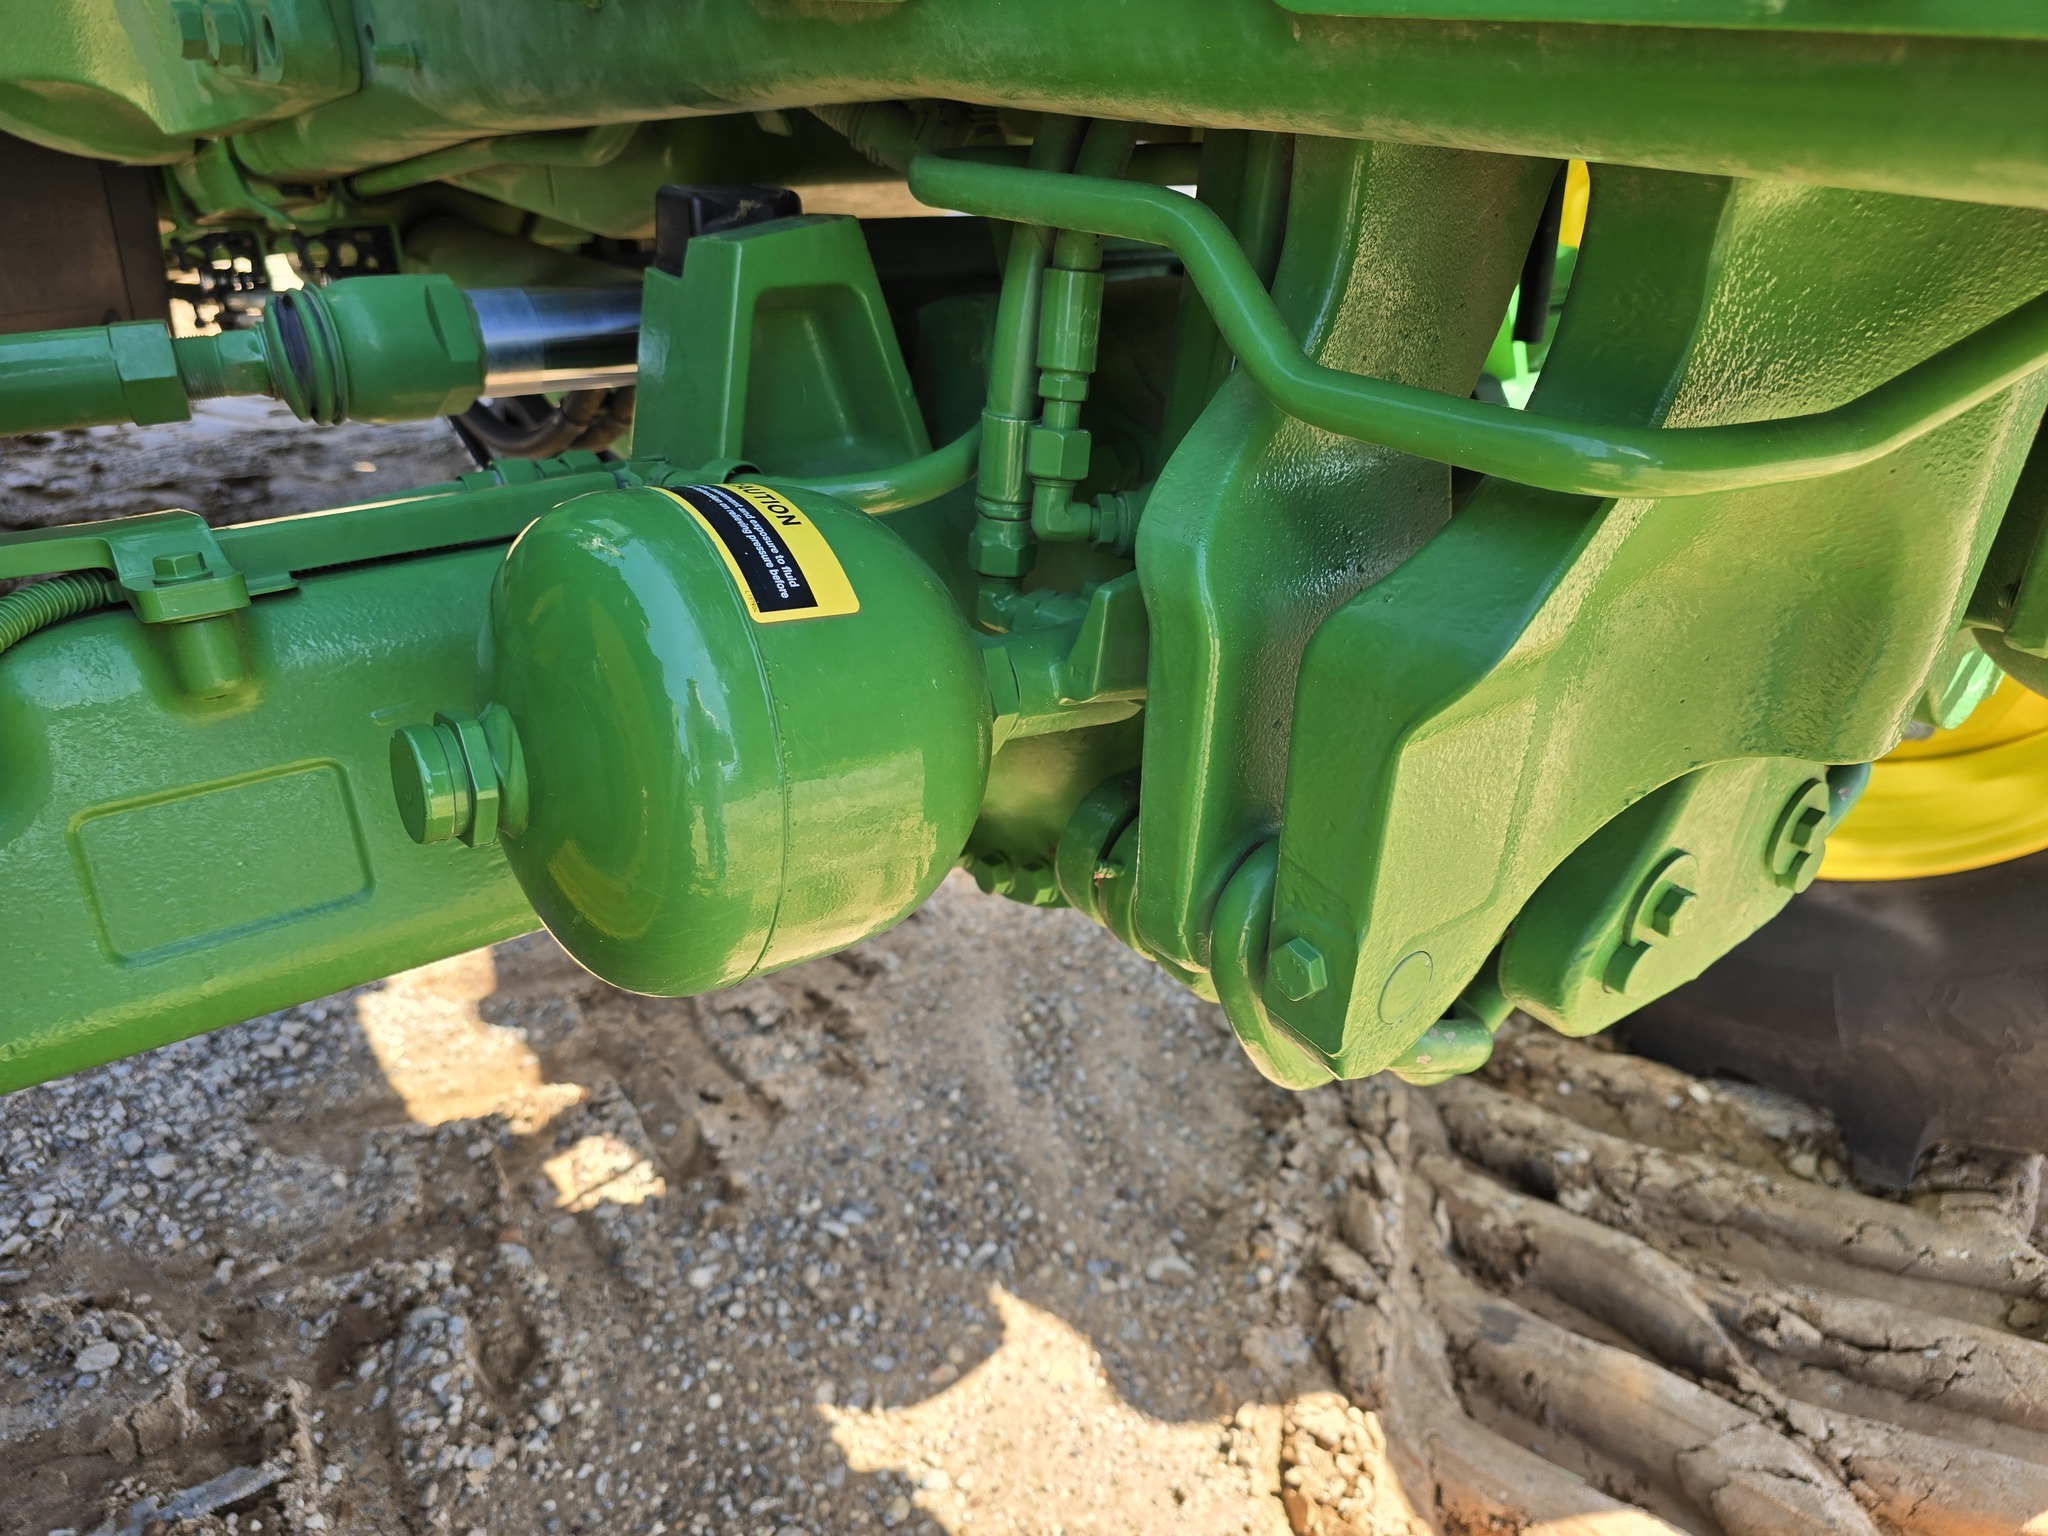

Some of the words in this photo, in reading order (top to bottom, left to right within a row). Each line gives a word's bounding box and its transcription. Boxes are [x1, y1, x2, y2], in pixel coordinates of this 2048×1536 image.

[735, 484, 802, 526] AUTION
[746, 535, 774, 568] pressure
[769, 569, 789, 599] before
[750, 519, 779, 554] exposure
[775, 555, 786, 565] to
[781, 566, 800, 588] fluid
